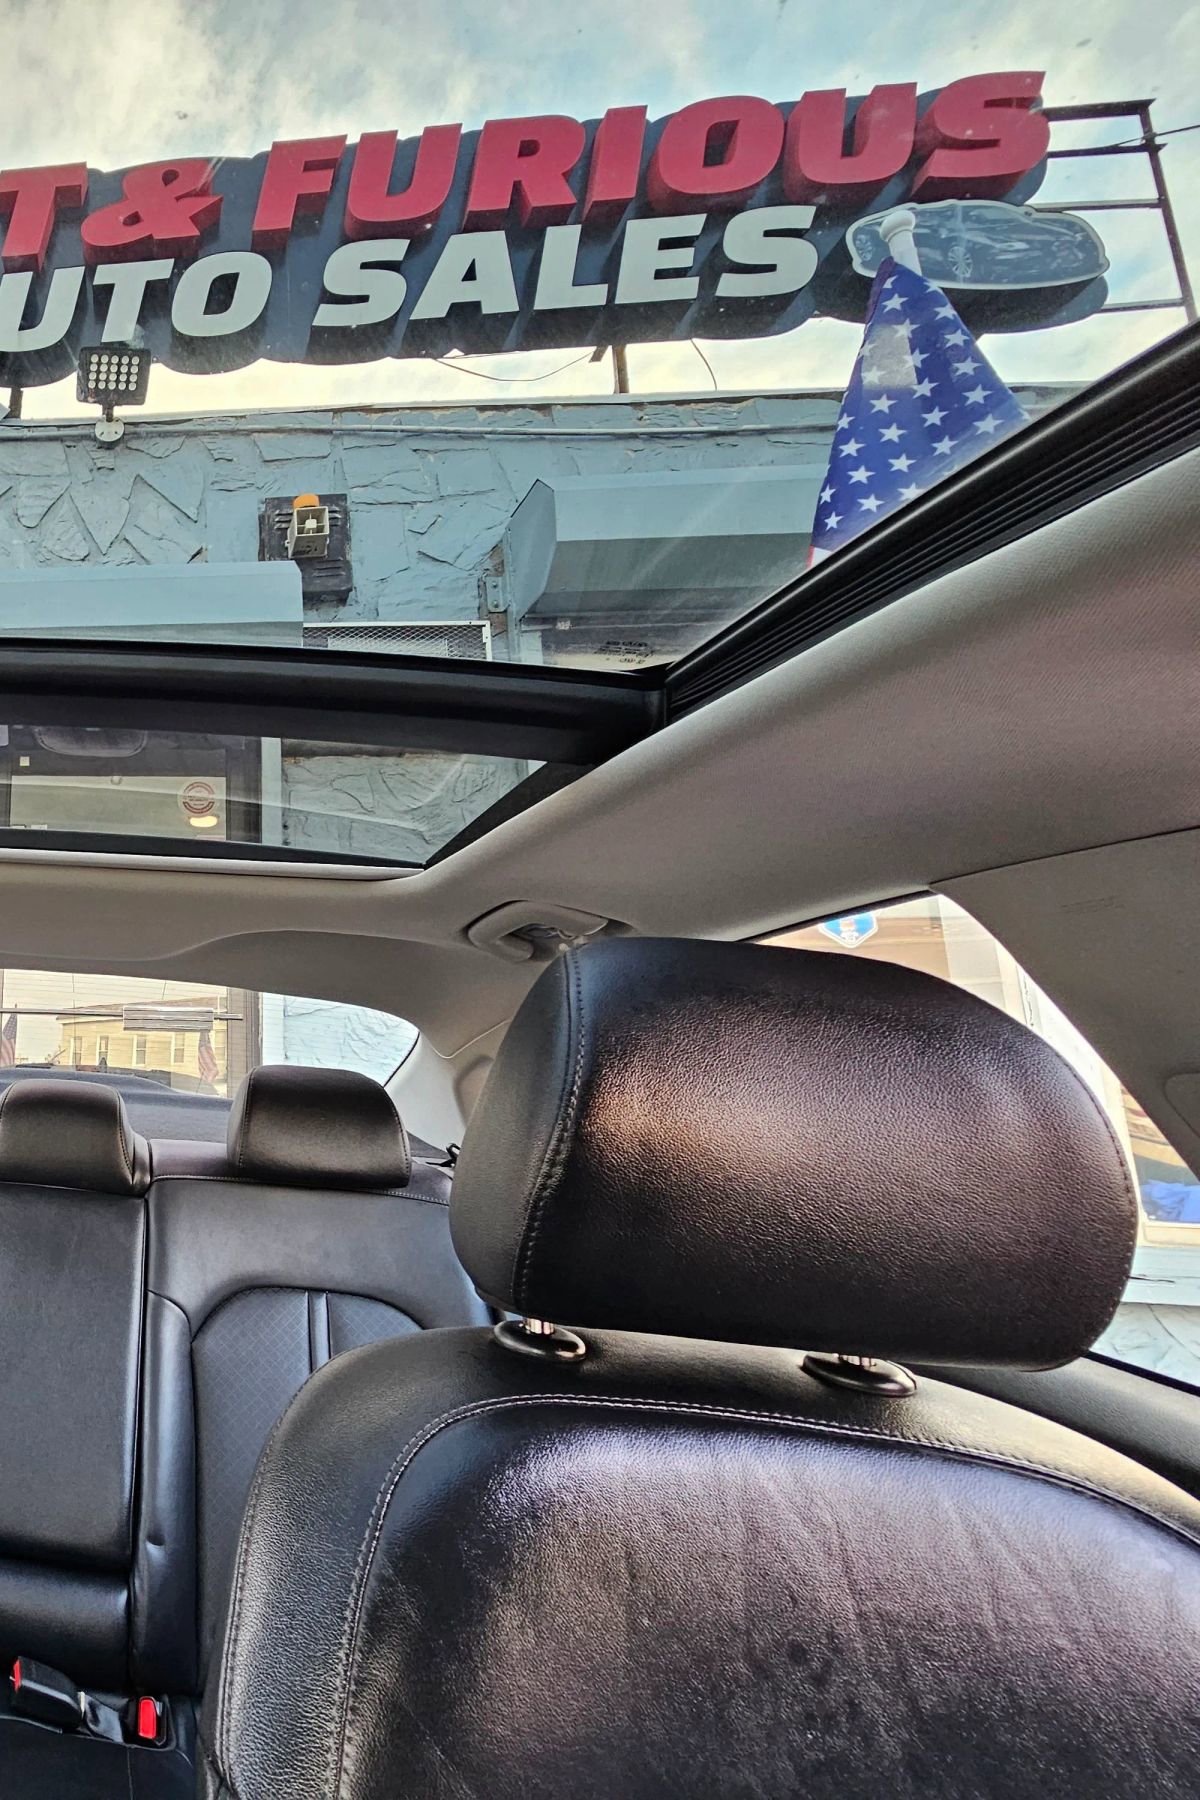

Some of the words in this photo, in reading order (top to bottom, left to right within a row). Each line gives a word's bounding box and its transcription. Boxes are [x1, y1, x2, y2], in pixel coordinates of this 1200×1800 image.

[81, 158, 224, 258] &
[252, 70, 1051, 250] FURIOUS
[313, 205, 819, 328] SALES
